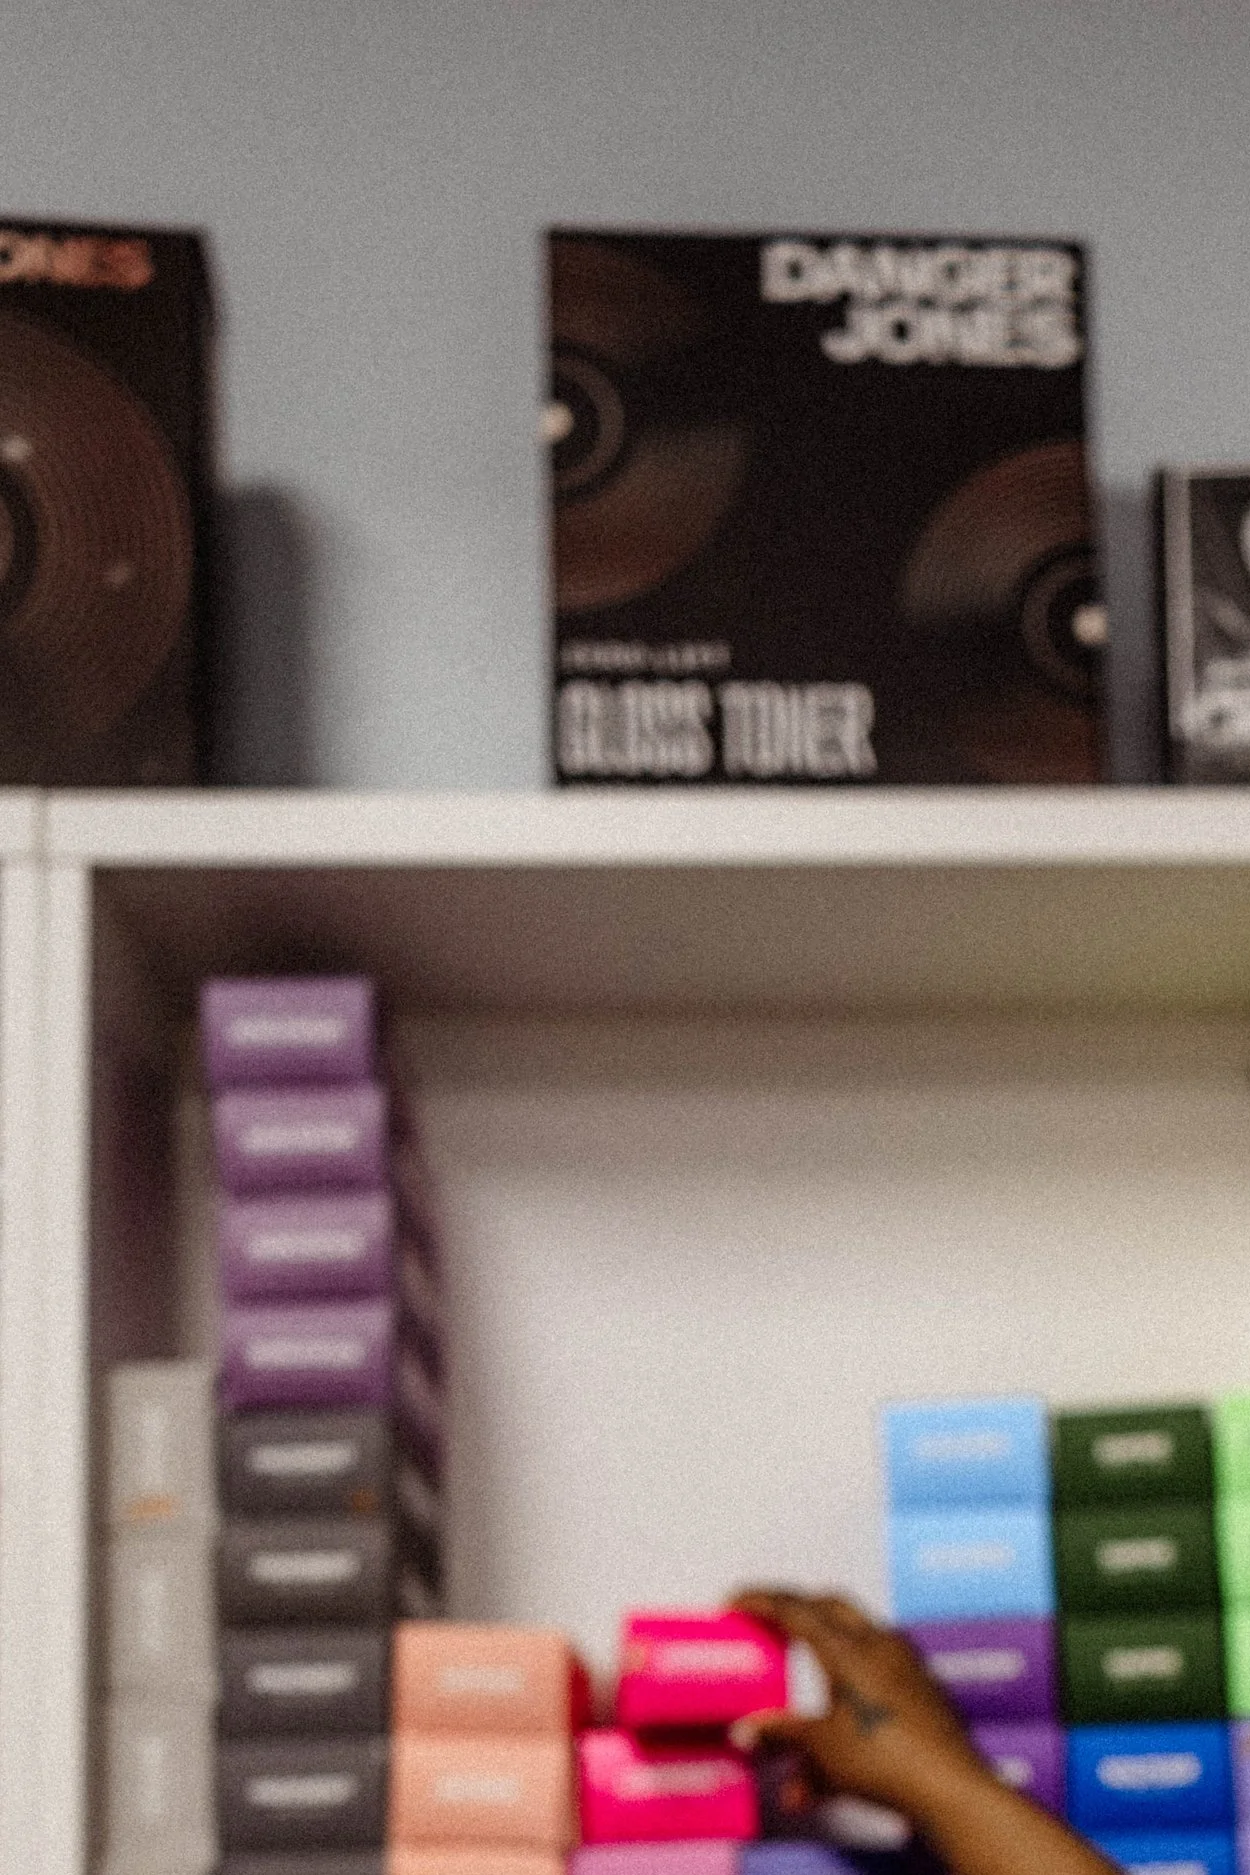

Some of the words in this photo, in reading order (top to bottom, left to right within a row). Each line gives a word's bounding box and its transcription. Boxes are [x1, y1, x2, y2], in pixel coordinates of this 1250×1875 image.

[762, 244, 1076, 303] DANGER
[820, 300, 1080, 368] JONES
[558, 680, 713, 777] GLOSS
[717, 680, 876, 778] TONER
